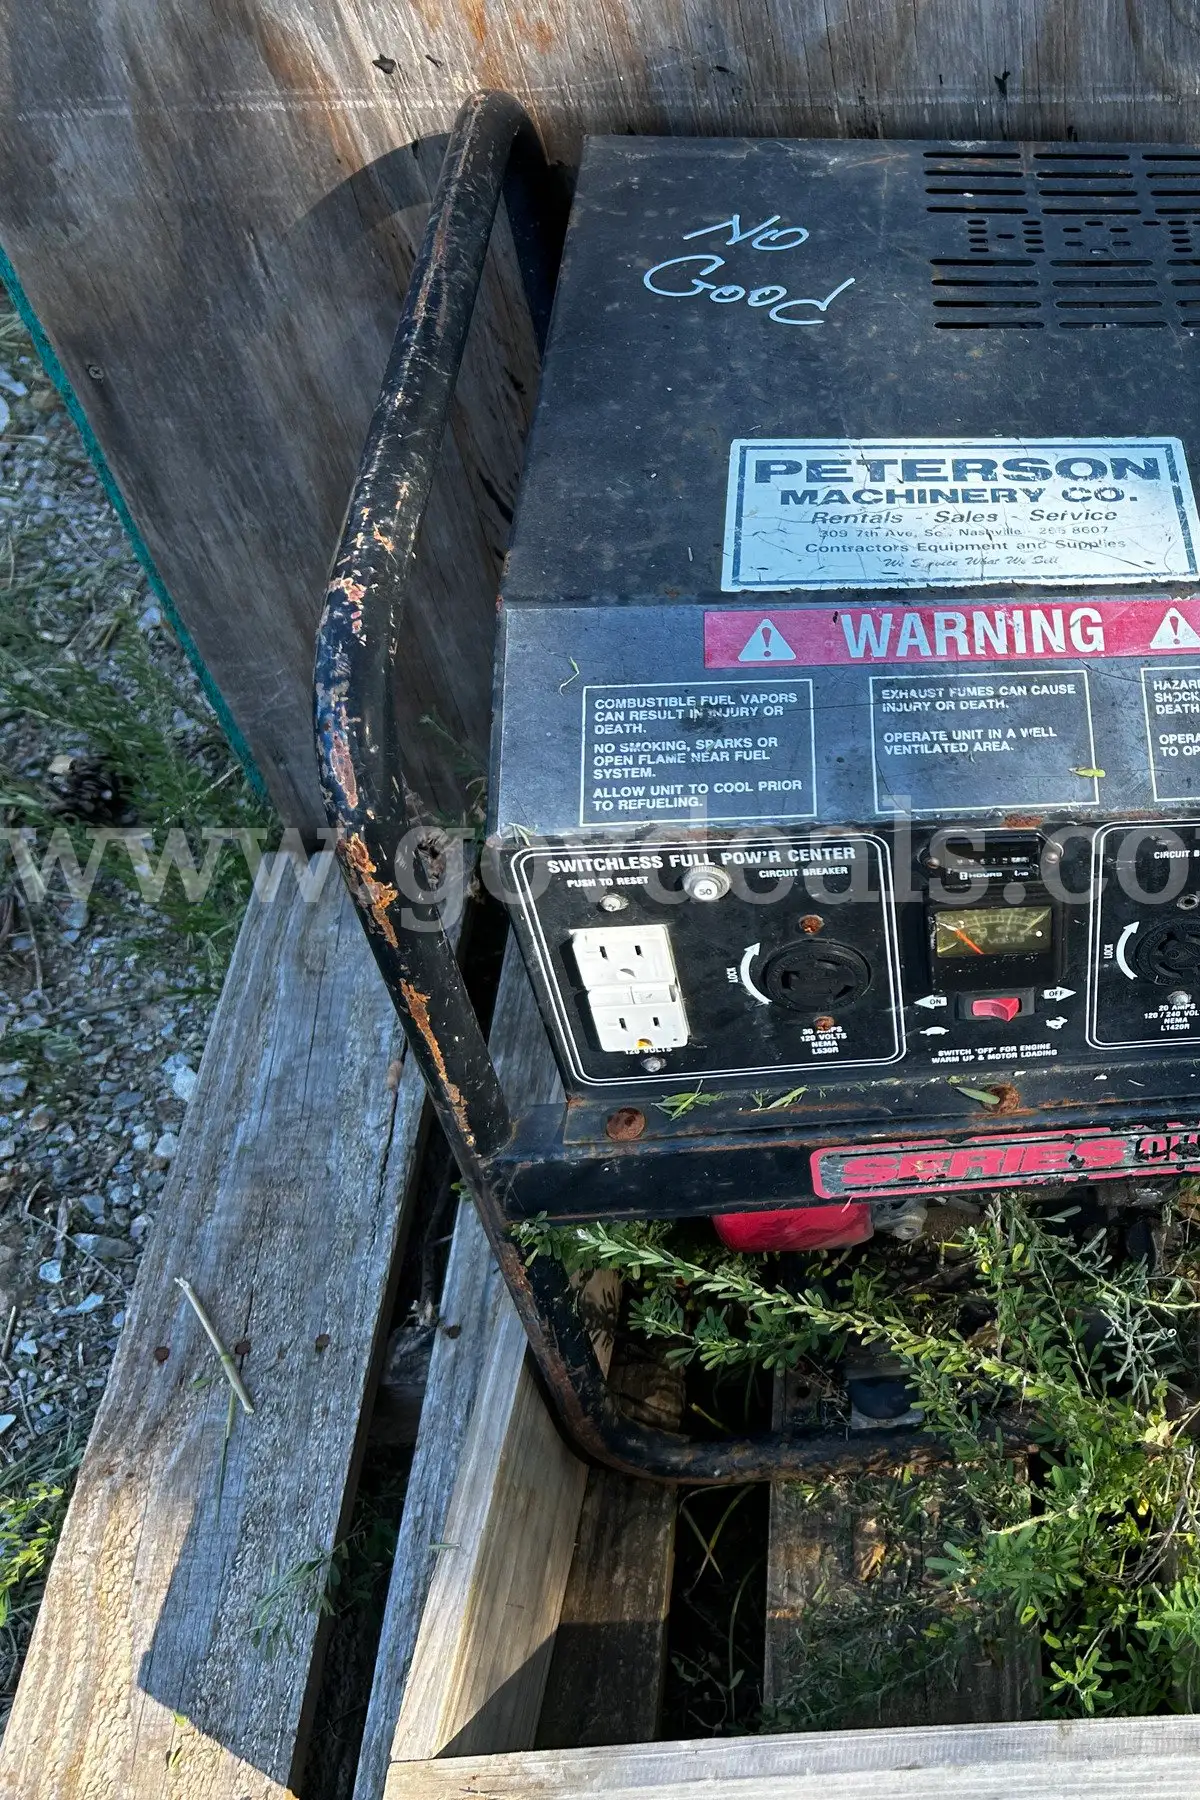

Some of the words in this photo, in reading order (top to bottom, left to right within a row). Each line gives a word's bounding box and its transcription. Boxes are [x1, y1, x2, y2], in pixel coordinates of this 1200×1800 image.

[755, 457, 1160, 483] PETERSON
[780, 488, 1047, 505] MACHINERY
[1062, 487, 1138, 502] CO.
[812, 512, 903, 524] Rentals
[934, 510, 998, 523] Sales
[1030, 509, 1117, 521] Service
[856, 529, 879, 538] 7th
[959, 527, 1022, 537] Nashville
[805, 543, 909, 552] Contractors
[917, 542, 1008, 552] Equipment
[1016, 540, 1047, 550] and
[1056, 540, 1126, 551] Supplies
[839, 608, 1105, 661] WARNING
[882, 687, 944, 699] EXHAUST
[950, 686, 994, 697] FUMES
[999, 685, 1026, 696] CAN
[1031, 684, 1076, 695] CAUSE
[594, 697, 696, 710] COMBUSTIBLE
[701, 695, 735, 706] FUEL
[740, 693, 798, 704] VAPORS
[882, 701, 931, 713] INJURY
[936, 700, 955, 711] OR
[960, 699, 1009, 710] DEATH.
[594, 710, 624, 722] CAN
[630, 709, 684, 720] RESULT
[690, 708, 703, 720] IN
[708, 707, 758, 718] INJURY
[763, 705, 784, 716] OR
[594, 724, 647, 735] DEATH.
[883, 731, 947, 743] OPERATE
[952, 729, 983, 740] UNIT
[988, 728, 1002, 739] IN
[1006, 727, 1017, 738] A
[1020, 726, 1057, 738] WELL
[594, 743, 615, 754] NO
[619, 741, 691, 753] SMOKING,
[696, 738, 752, 750] SPARKS
[757, 737, 778, 748] OR
[884, 743, 968, 755] VENTILATED
[974, 740, 1014, 752] AREA.
[1160, 746, 1178, 757] TO
[593, 755, 633, 767] OPEN
[639, 753, 685, 765] FLAME
[691, 752, 730, 763] NEAR
[734, 750, 770, 761] FUEL
[593, 767, 656, 780] SYSTEM.
[592, 786, 645, 798] ALLOW
[651, 784, 683, 796] UNIT
[688, 783, 709, 794] TO
[714, 782, 753, 794] COOL
[759, 780, 802, 791] PRIOR
[593, 800, 614, 811] TO
[619, 797, 703, 810] REFUELING.
[547, 855, 664, 874] SWITCHLESS
[669, 853, 715, 868] FULL
[721, 850, 781, 865] POW'R
[788, 847, 856, 862] CENTER
[1154, 850, 1190, 860] CIRCUIT
[759, 868, 799, 878] CIRCUIT
[803, 866, 848, 877] BREAKER
[567, 877, 596, 888] PUSH
[600, 878, 614, 886] TO
[617, 876, 649, 886] RESET
[1103, 943, 1114, 959] LOCK
[726, 967, 737, 983] LOCK
[1171, 1003, 1196, 1011] AMPS
[931, 1056, 959, 1064] WARM
[987, 1052, 1018, 1060] MOTOR
[1021, 1049, 1058, 1058] LOADING
[938, 1049, 971, 1057] SWITCH
[1020, 1043, 1051, 1051] ENGINE
[843, 1138, 1128, 1185] SERIES
